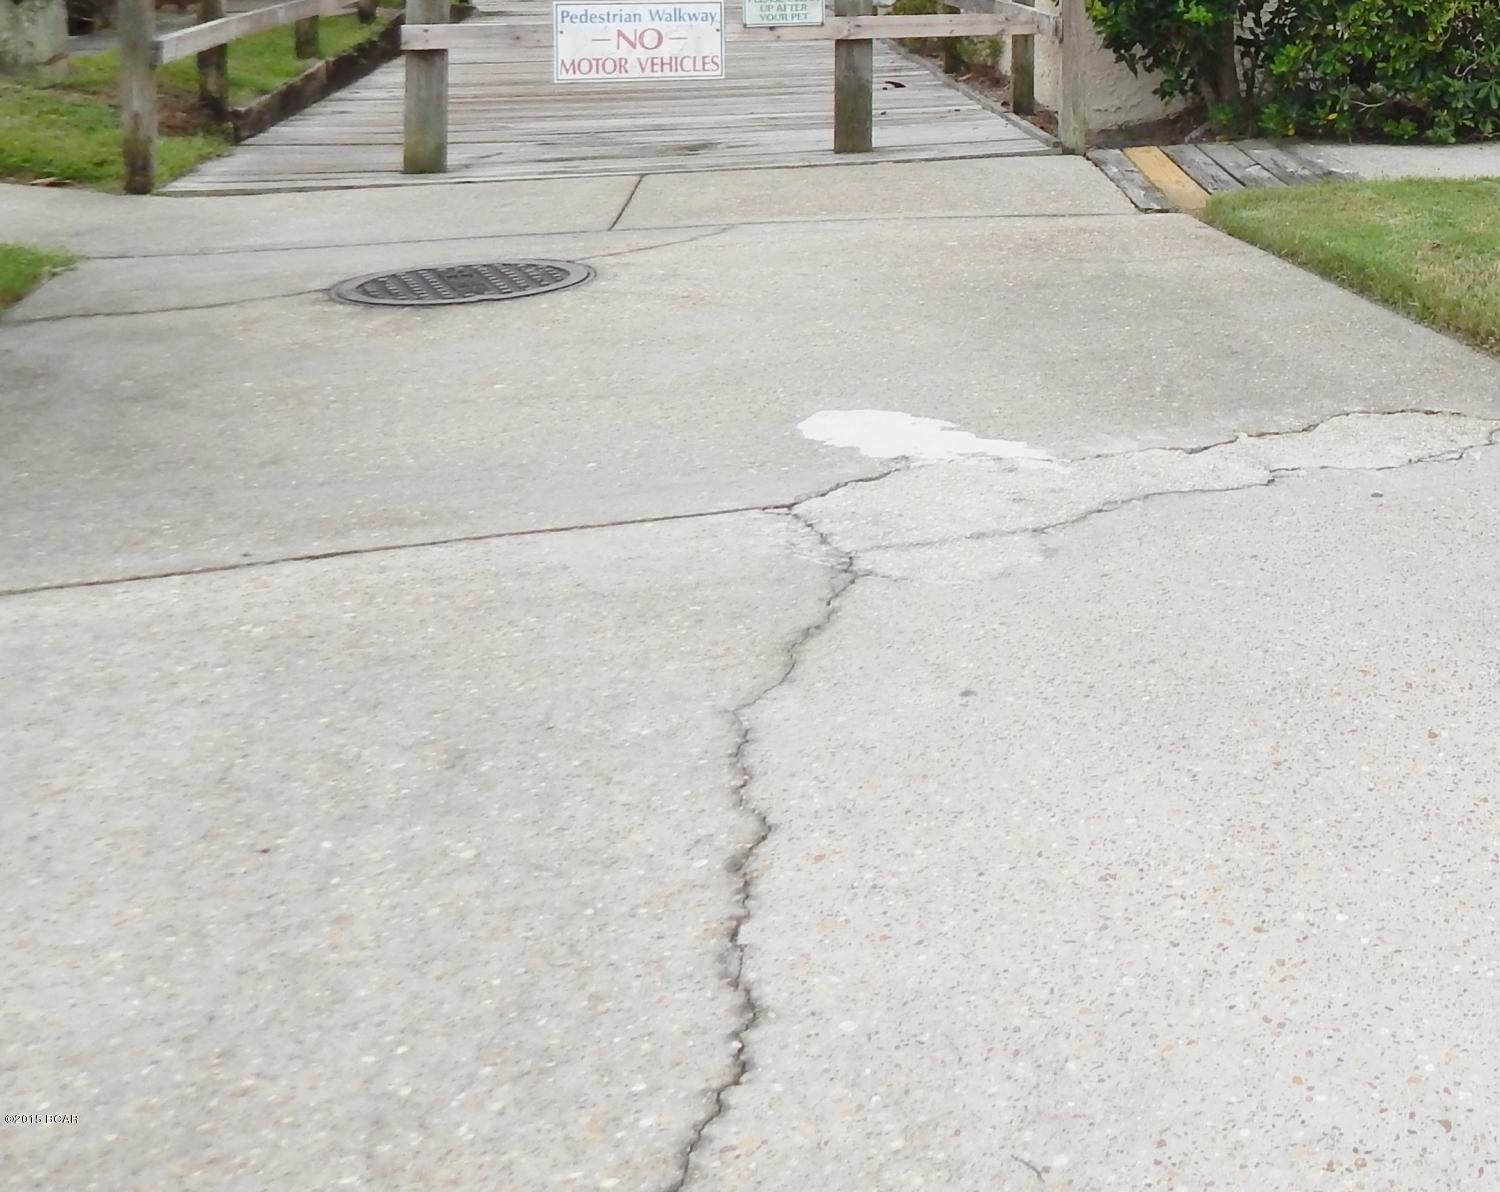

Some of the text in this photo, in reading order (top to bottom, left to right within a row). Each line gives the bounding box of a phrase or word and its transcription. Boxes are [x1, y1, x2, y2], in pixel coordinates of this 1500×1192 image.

[560, 7, 717, 26] Pedestrian Walkway
[760, 3, 807, 12] UP AFTER
[760, 12, 808, 22] YOUR PET
[616, 28, 664, 50] NO
[560, 55, 720, 75] MOTOR VEHICLES
